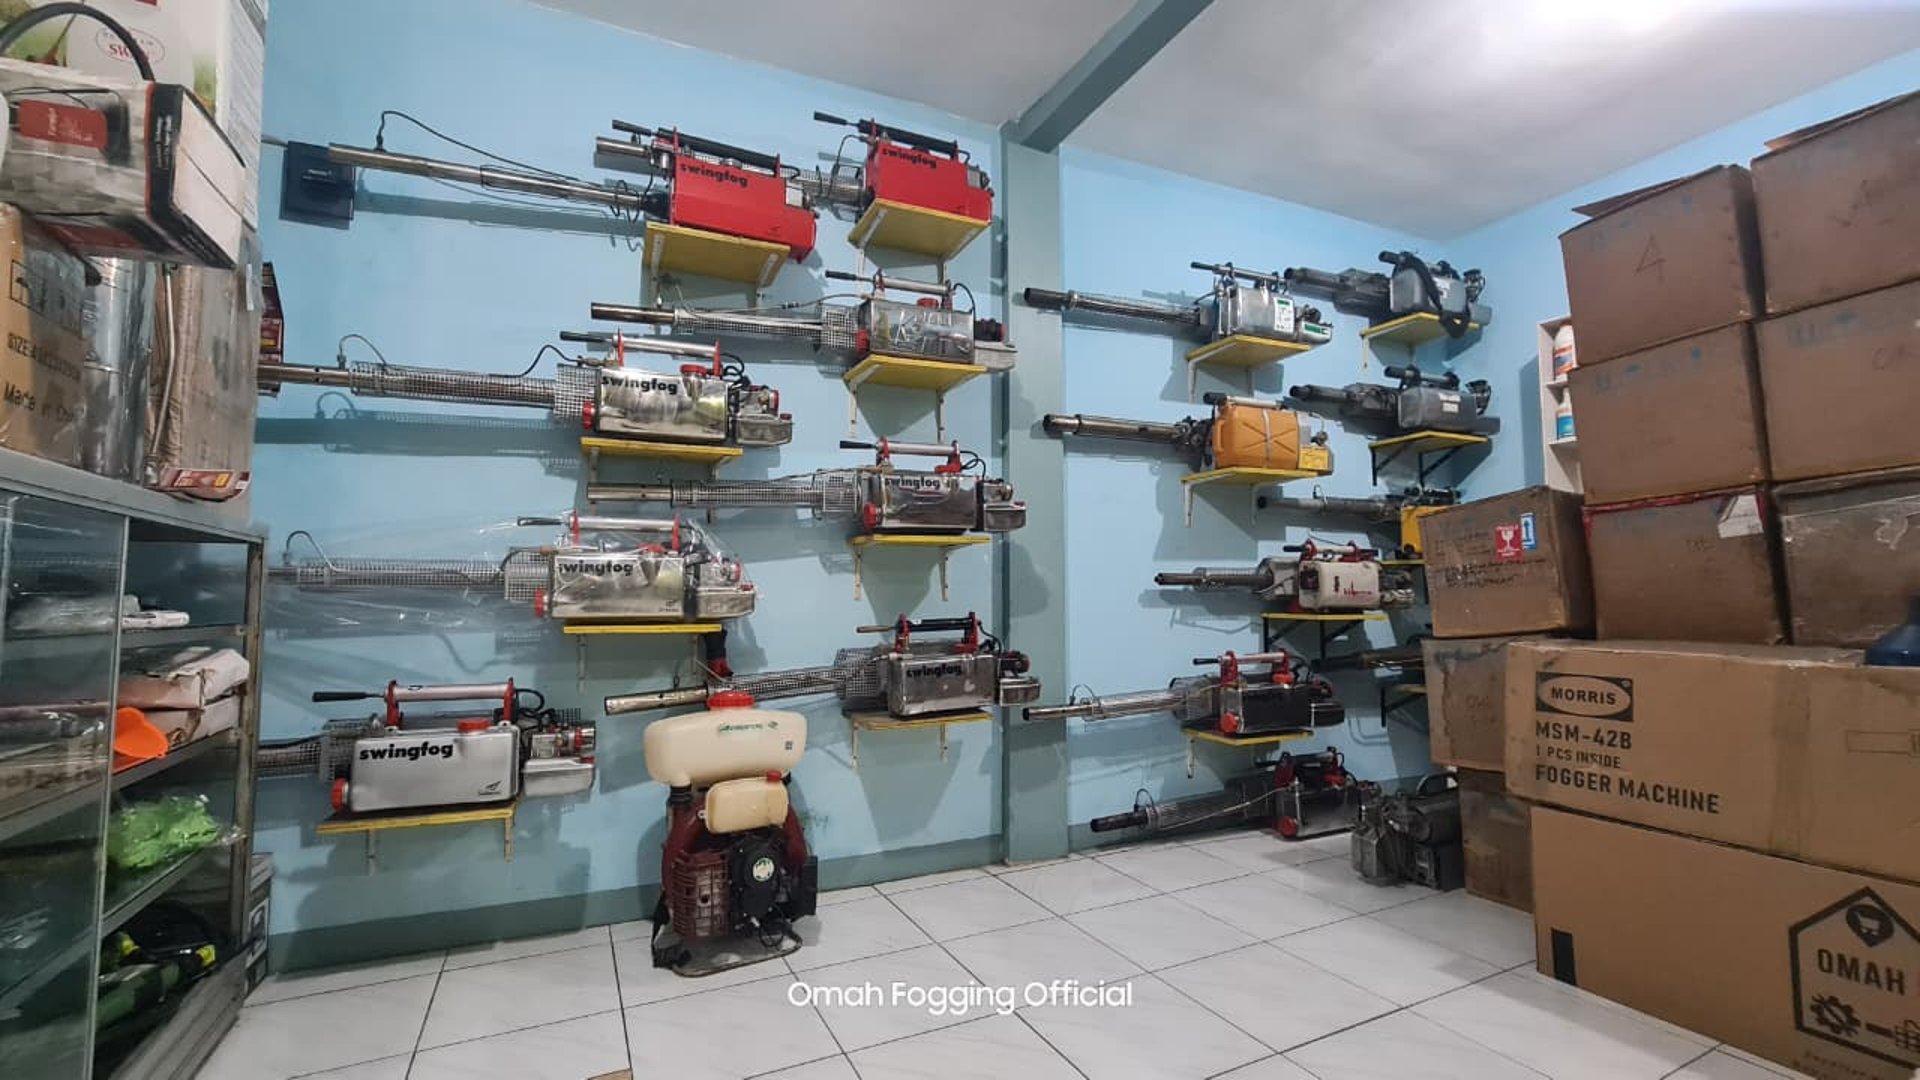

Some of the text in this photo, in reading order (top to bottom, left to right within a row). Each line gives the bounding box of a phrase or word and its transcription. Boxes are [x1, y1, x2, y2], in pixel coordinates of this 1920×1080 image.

[881, 148, 937, 169] swingfog
[681, 163, 748, 188] swingfog
[601, 375, 678, 395] swingfog
[1550, 686, 1617, 706] MORRIS
[1536, 719, 1632, 750] MSM-42B
[359, 741, 454, 762] swingfog
[1547, 746, 1573, 762] PCS
[1576, 751, 1621, 769] INSIDE
[1536, 764, 1720, 814] FOGGER MACHINE
[1817, 948, 1906, 996] OMAH
